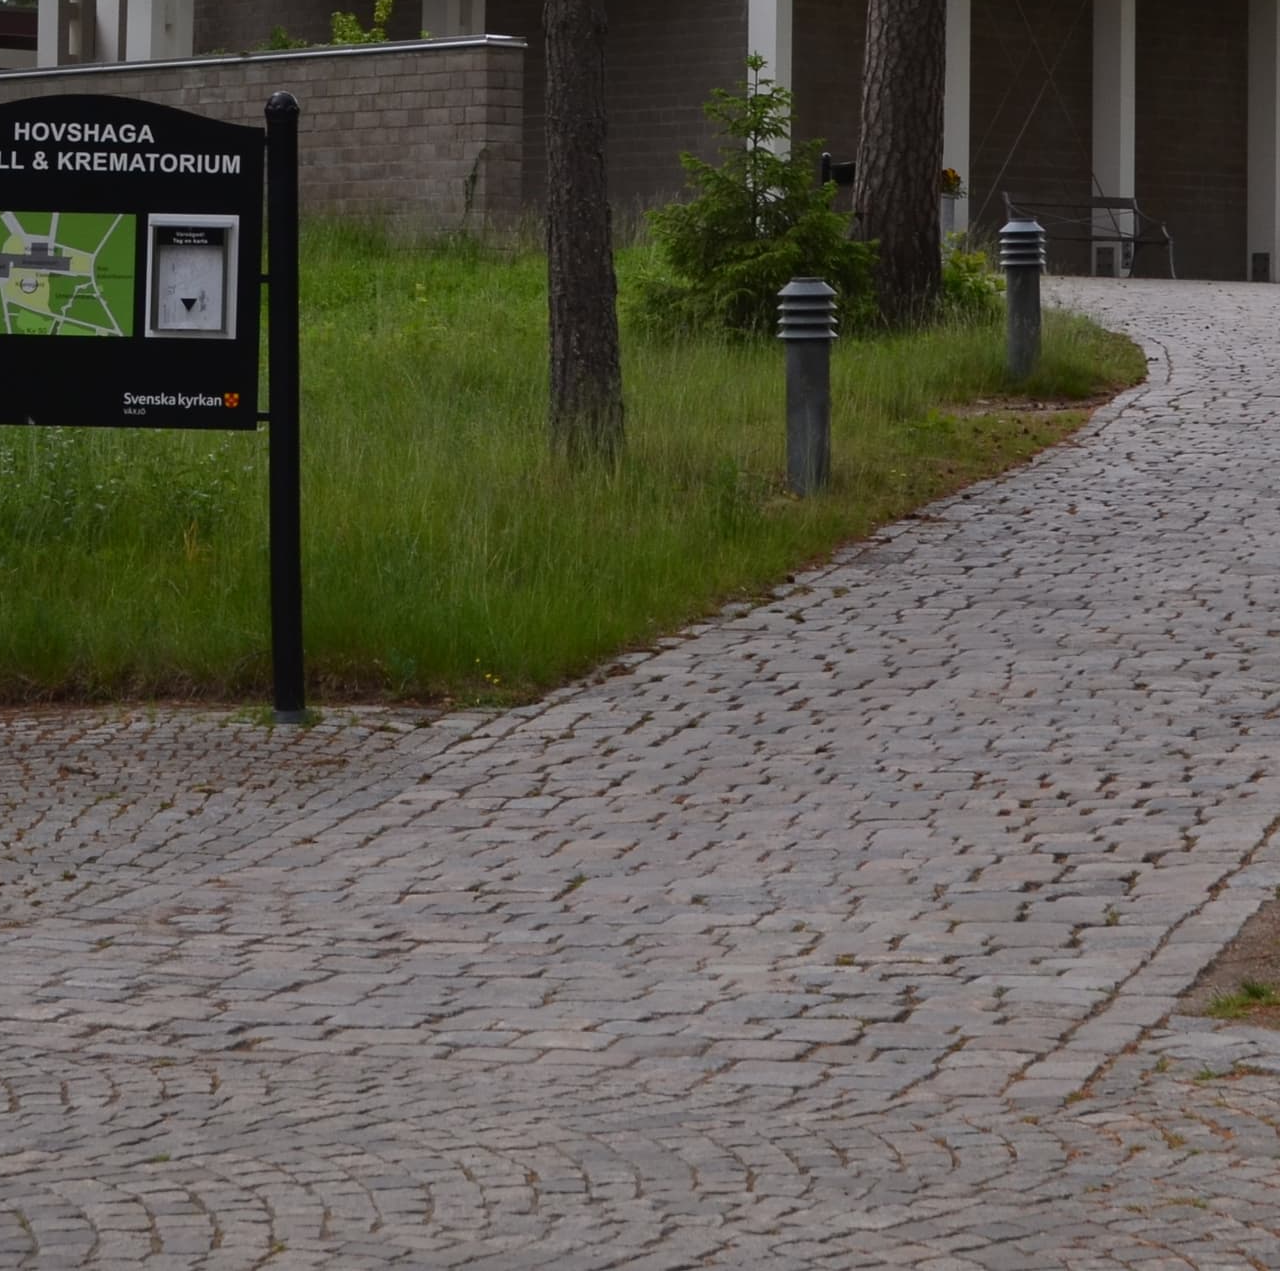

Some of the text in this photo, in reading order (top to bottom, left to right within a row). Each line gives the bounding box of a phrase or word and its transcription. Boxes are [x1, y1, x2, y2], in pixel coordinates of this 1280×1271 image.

[14, 122, 155, 144] HOVSHAGA
[33, 151, 49, 171] &
[57, 151, 241, 175] KREMATORIUM
[123, 392, 222, 409] Svenska kyrkan
[123, 408, 146, 416] VÄXJÖ
